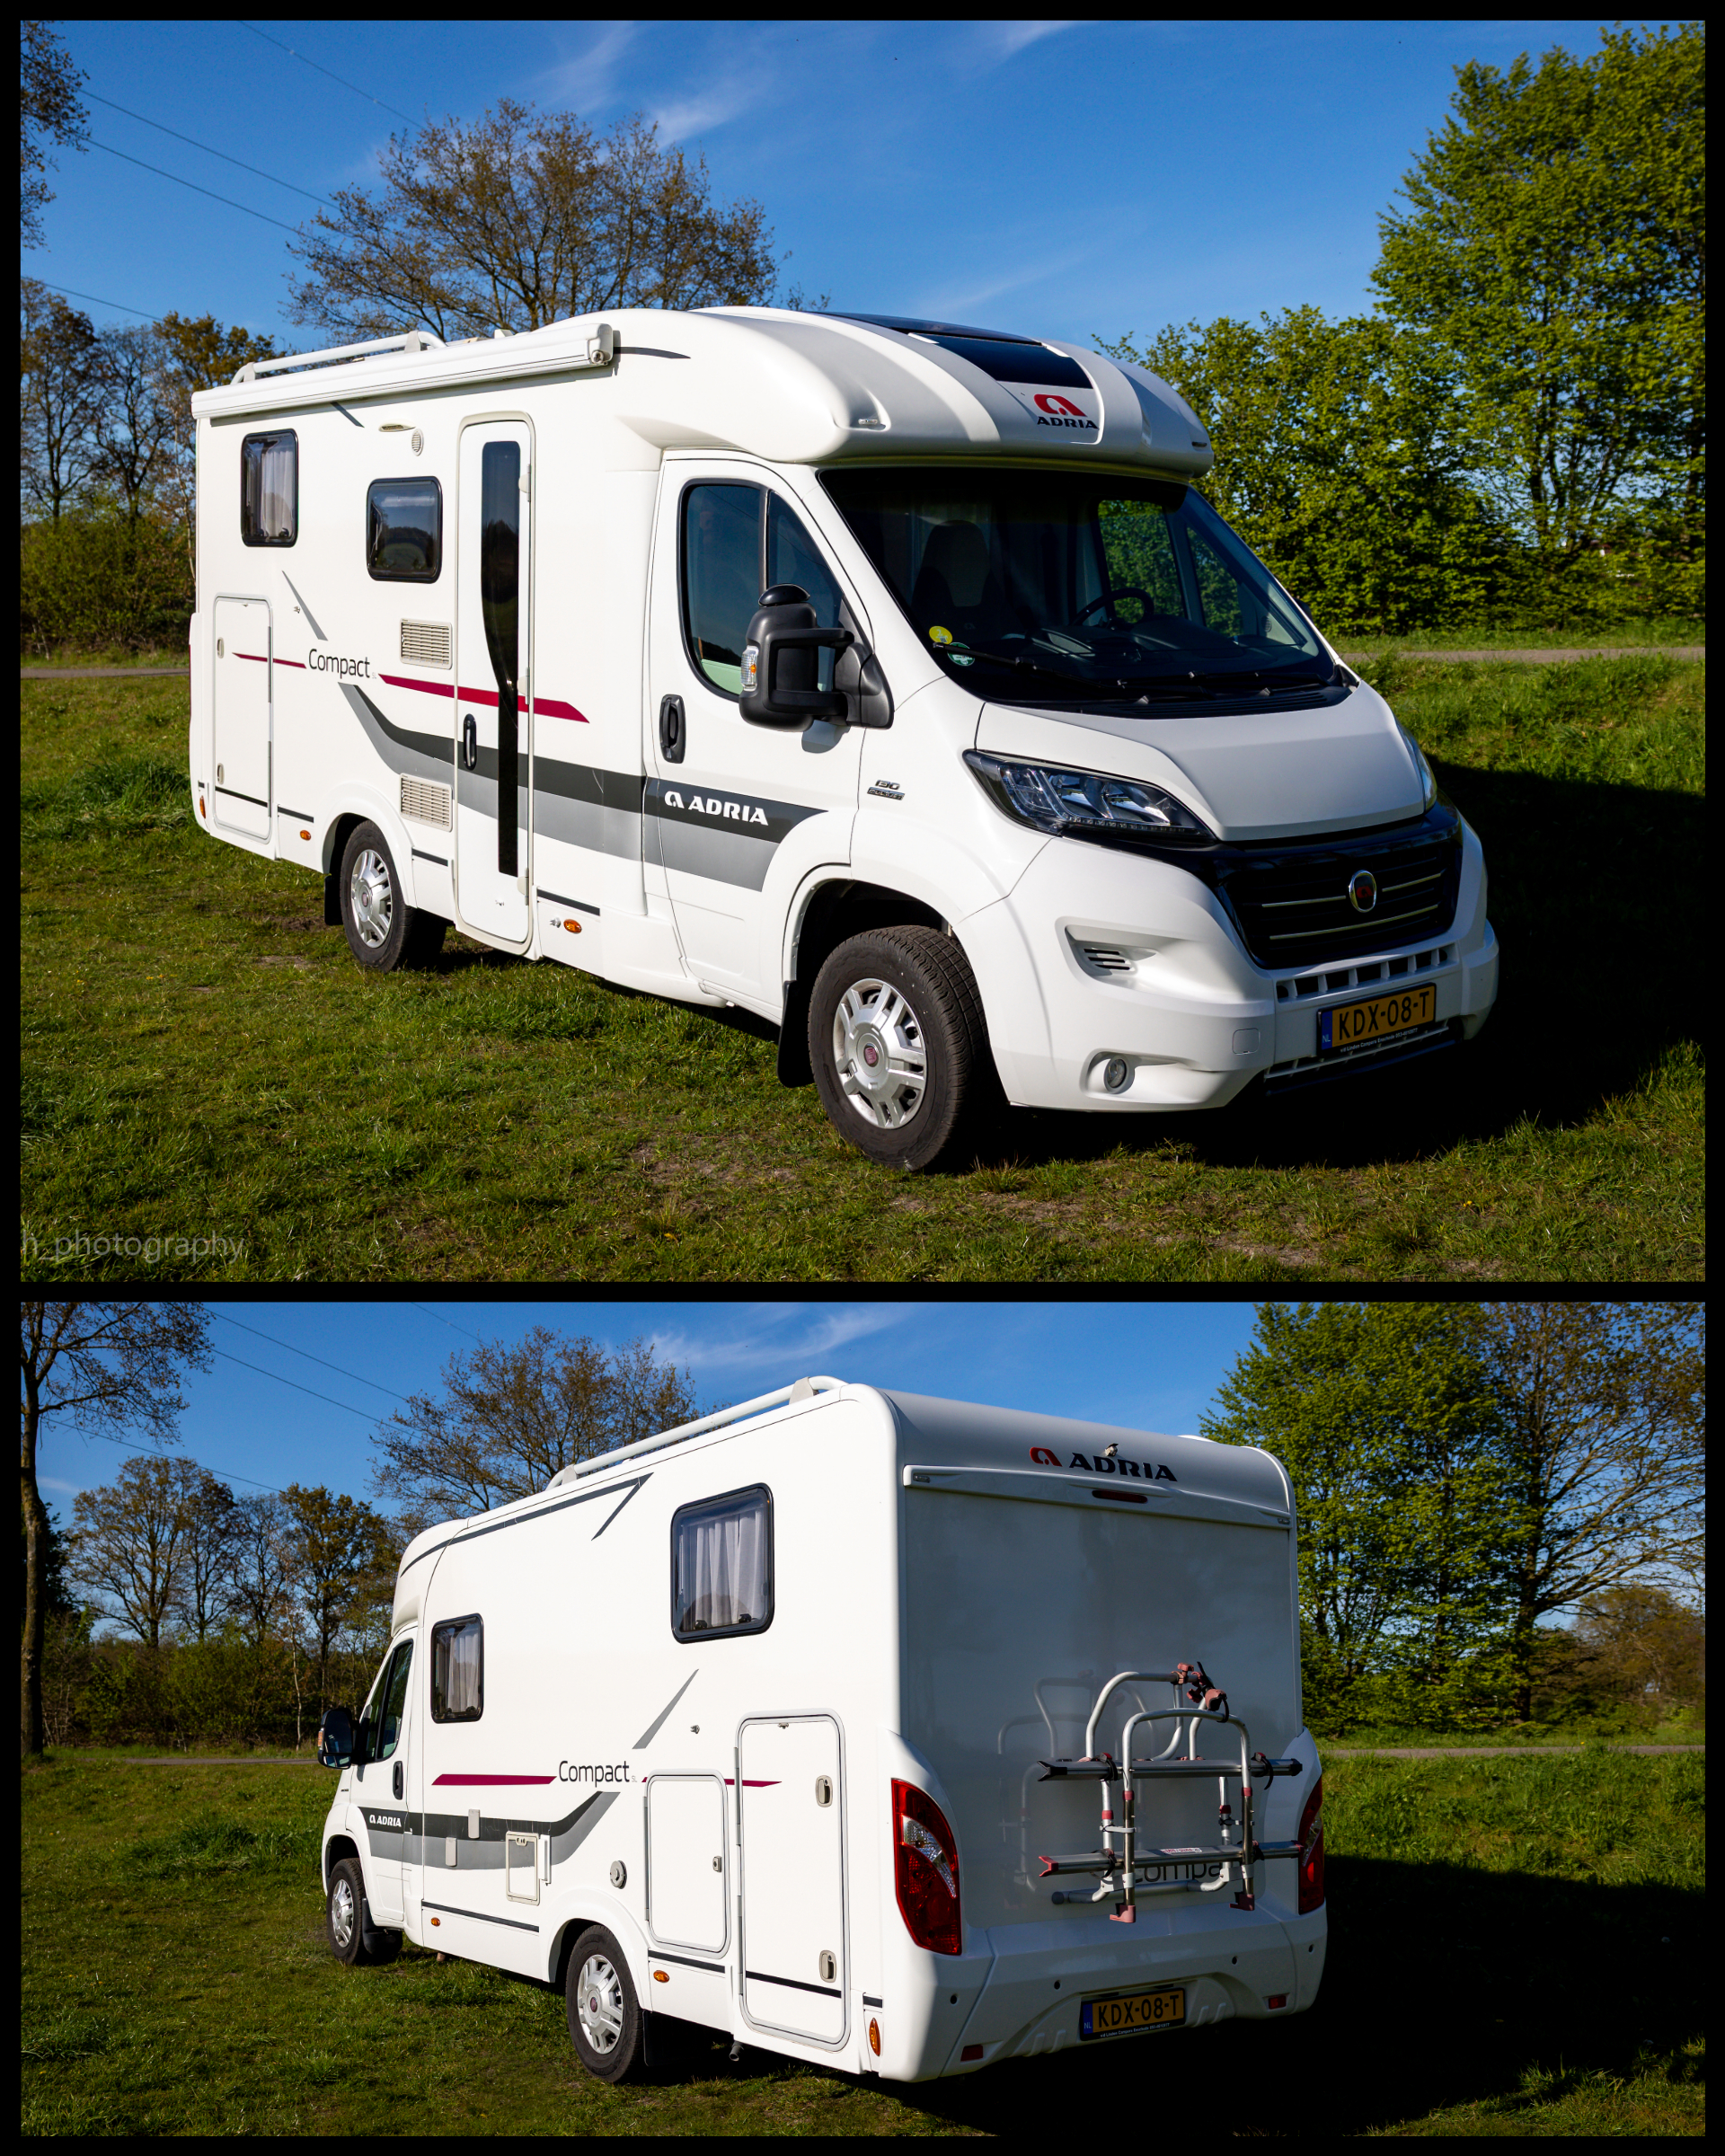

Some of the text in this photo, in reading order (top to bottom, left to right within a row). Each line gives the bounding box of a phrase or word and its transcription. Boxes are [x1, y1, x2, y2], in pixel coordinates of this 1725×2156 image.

[1037, 416, 1099, 429] ADRIA
[309, 649, 370, 679] Compact
[688, 795, 769, 826] ADRIA
[1339, 991, 1429, 1040] KDX-08-T
[1322, 1034, 1331, 1043] NL
[1069, 1452, 1178, 1482] ADRIA
[559, 1761, 630, 1788] Compact
[376, 1815, 402, 1827] ADRIA
[1084, 2021, 1092, 2029] NL
[1098, 1994, 1179, 2028] KDX-08-T
